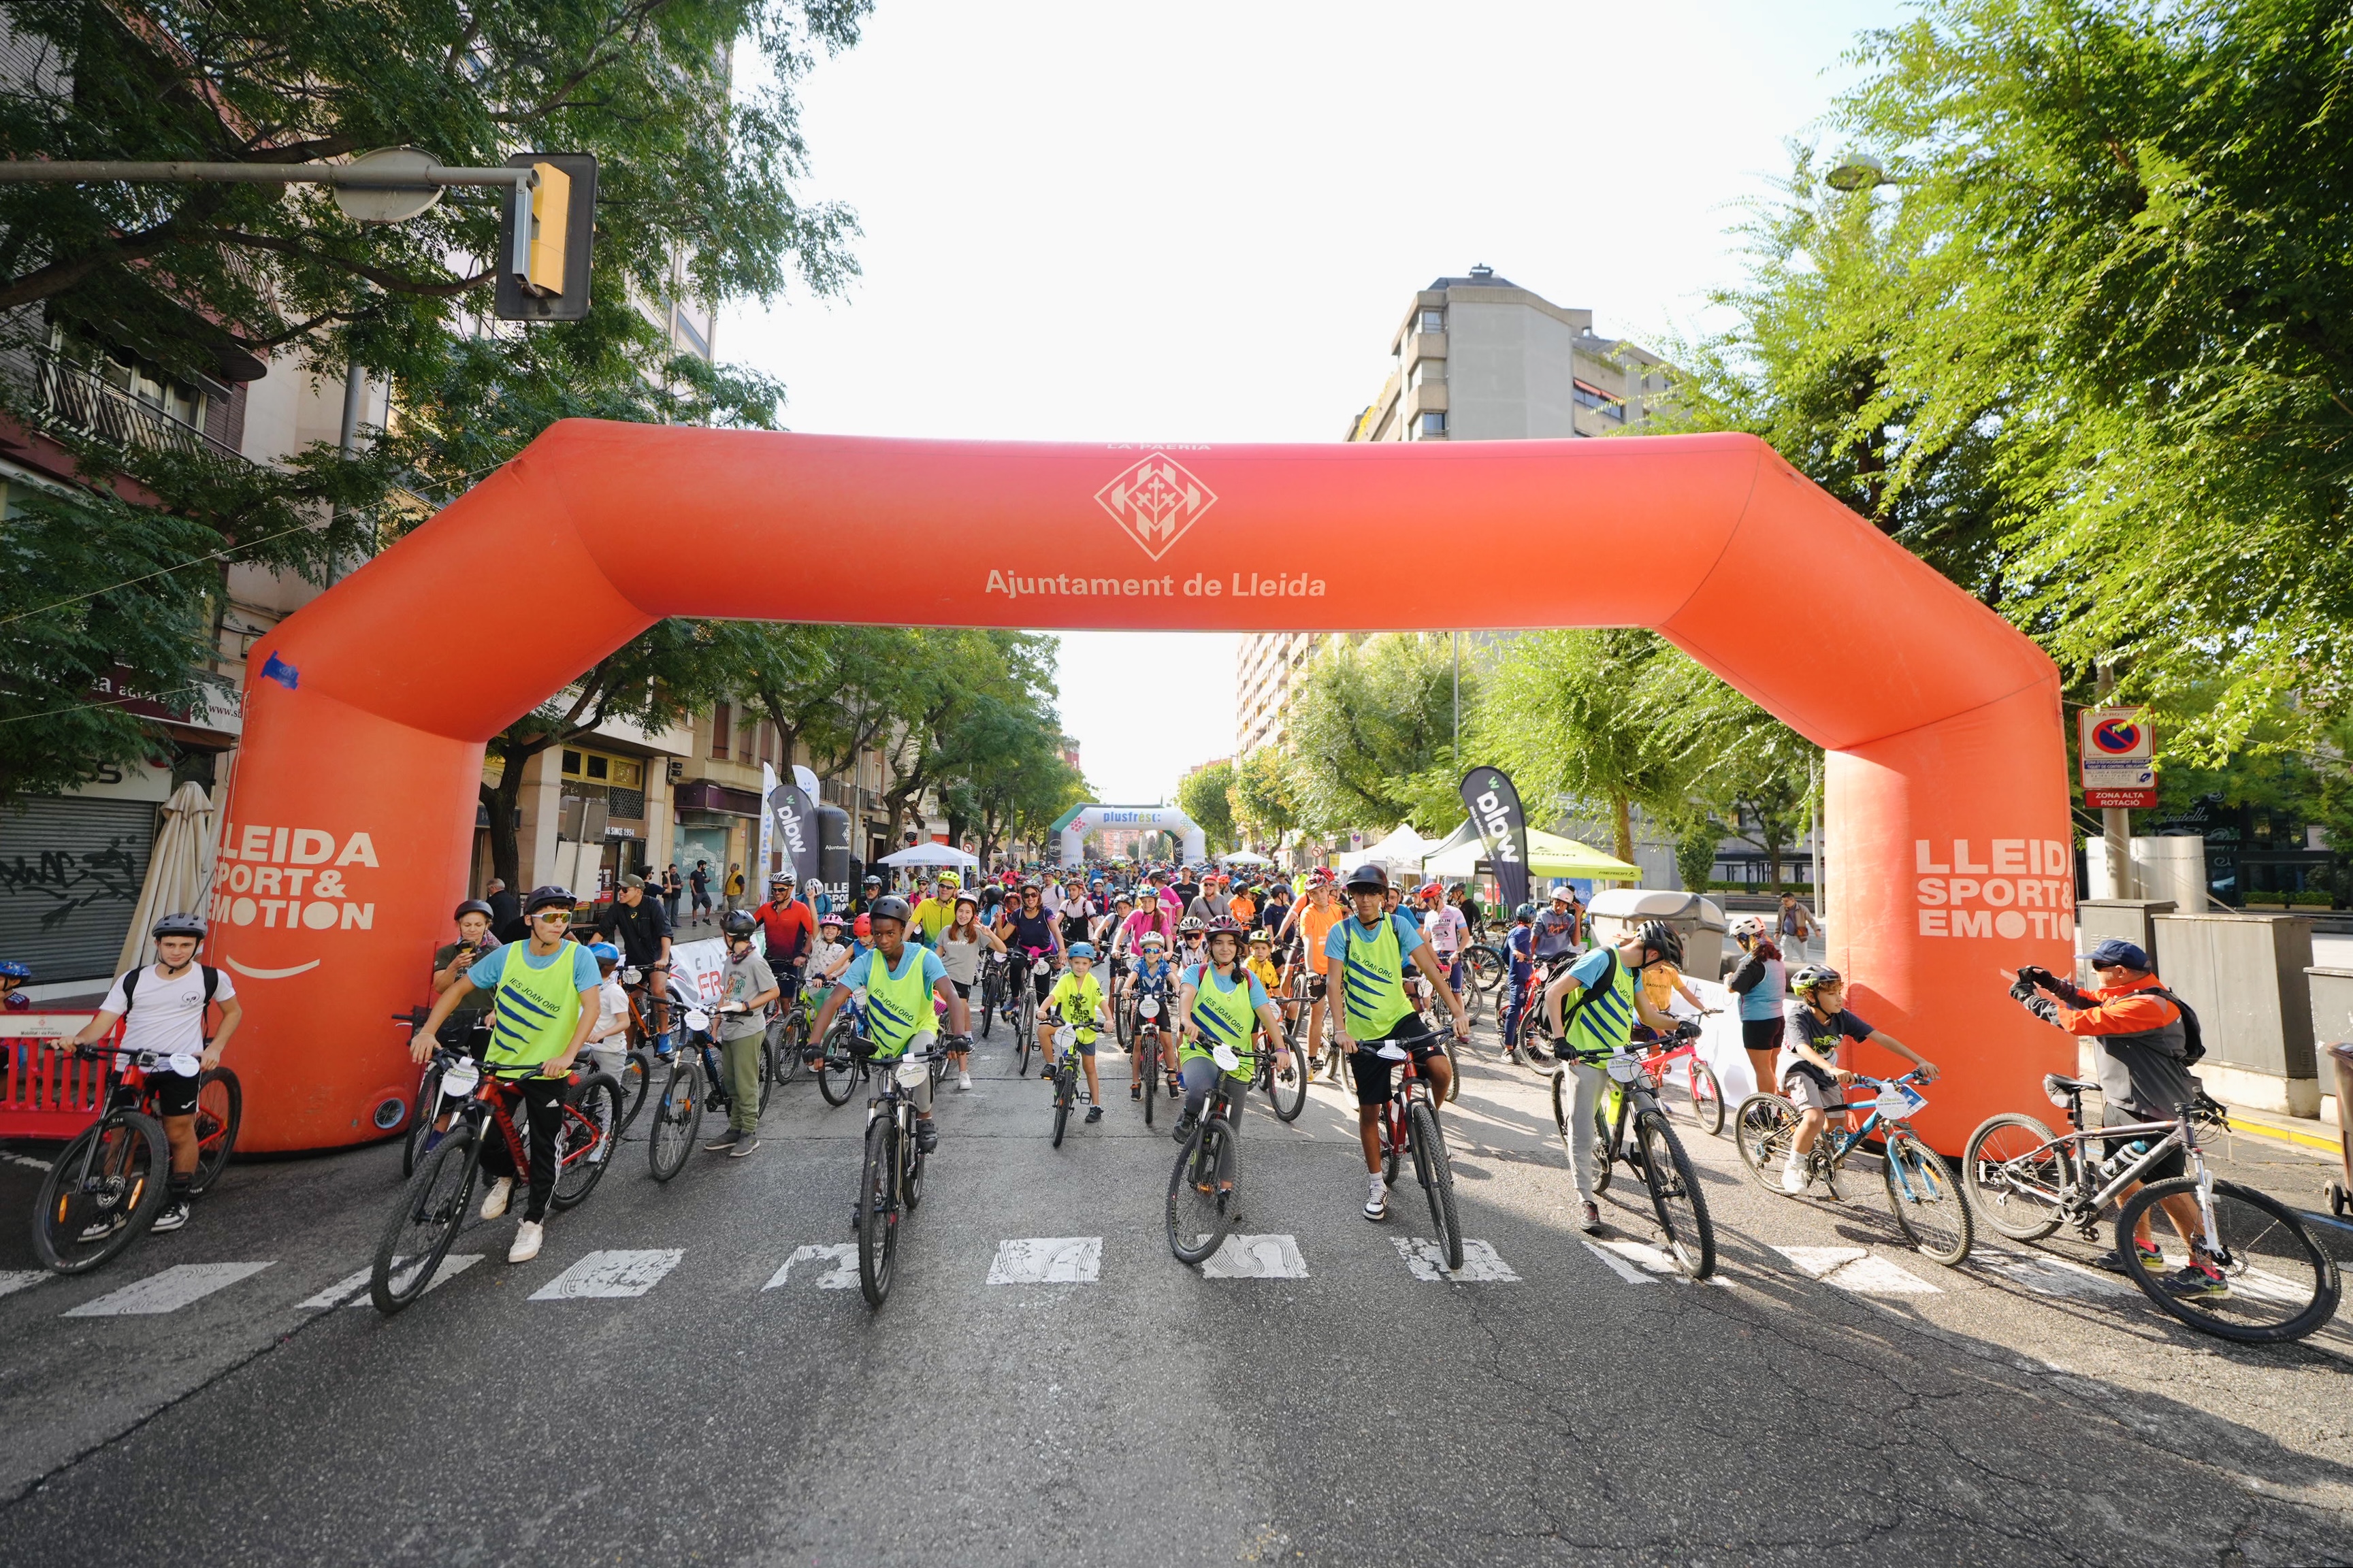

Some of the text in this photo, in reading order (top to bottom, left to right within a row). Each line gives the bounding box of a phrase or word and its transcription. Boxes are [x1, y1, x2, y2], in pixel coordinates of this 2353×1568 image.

[1139, 442, 1212, 451] PAERIA
[985, 570, 1326, 599] Ajuntament de Lleida
[217, 822, 380, 868] LEIDA
[611, 827, 623, 836] SINCE
[623, 828, 635, 836] 1954
[1917, 877, 2073, 910] SPORT&
[1918, 909, 2075, 941] EMOTIO
[1351, 951, 1393, 979] IES JOAN ORÓ
[509, 977, 562, 1013] IES JOAN ORÓ
[873, 987, 914, 1022] IES JOAN ORÓ
[1620, 987, 1631, 1002] JOA
[1204, 996, 1244, 1032] IES JOAN ORÓ
